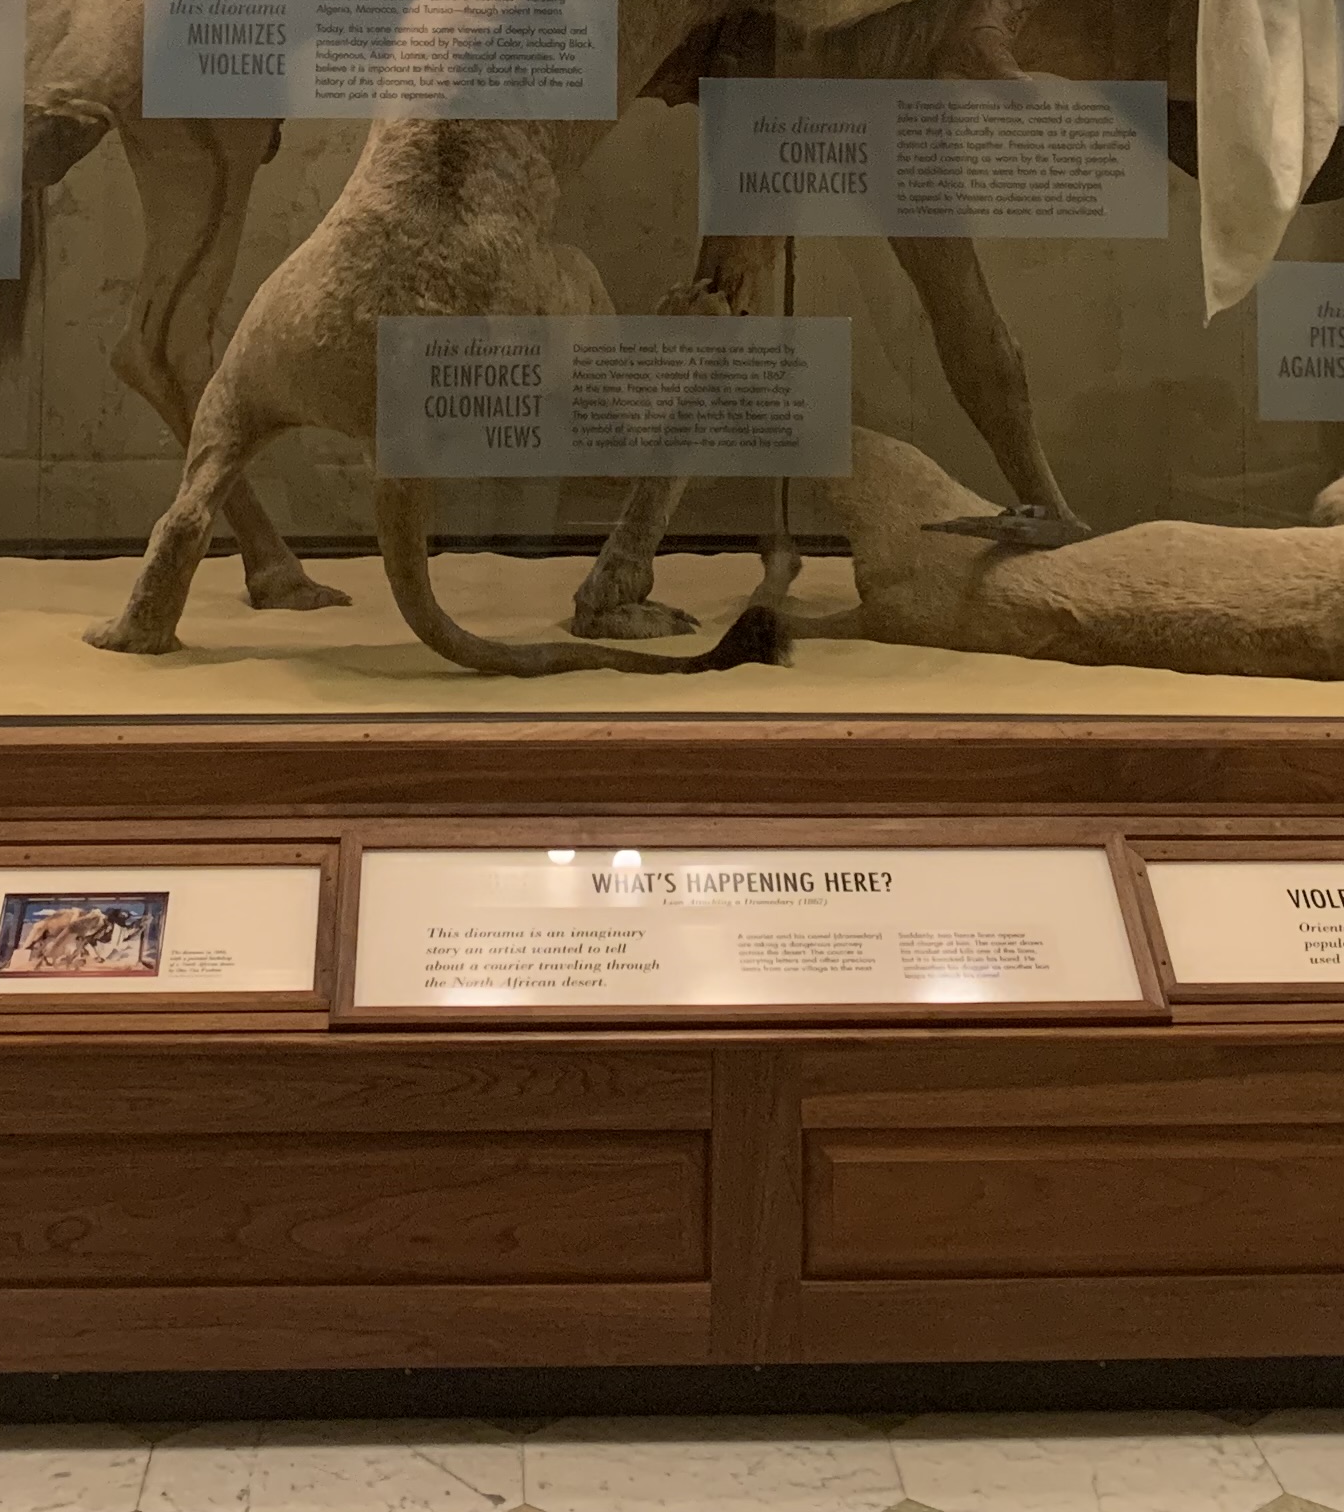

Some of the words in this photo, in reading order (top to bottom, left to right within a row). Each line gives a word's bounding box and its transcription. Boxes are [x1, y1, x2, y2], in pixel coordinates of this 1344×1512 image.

[187, 22, 287, 45] MINIMIZES
[198, 52, 285, 75] VIOLENCE
[752, 115, 786, 135] this
[790, 115, 868, 134] diorama
[778, 140, 868, 164] CONTAINS
[739, 170, 868, 194] INACCURACIES
[424, 338, 459, 358] this
[463, 336, 541, 357] diorama
[430, 363, 541, 387] REINFORCES
[423, 393, 541, 418] COLONIALIST
[484, 425, 541, 448] VIEWS
[591, 871, 677, 894] WHAT'S
[687, 871, 814, 893] HAPPENING
[825, 871, 893, 893] HERE?
[427, 927, 459, 938] This
[464, 927, 524, 937] diorama
[570, 930, 644, 940] imaginary
[426, 946, 458, 955] story
[488, 945, 526, 954] artist
[531, 942, 583, 954] wanted
[587, 945, 601, 954] to
[604, 942, 627, 953] tell
[1309, 952, 1340, 964] used
[424, 960, 464, 971] about
[538, 960, 601, 972] traveling
[606, 960, 660, 972] through
[424, 976, 446, 987] the
[561, 975, 606, 986] desert.
